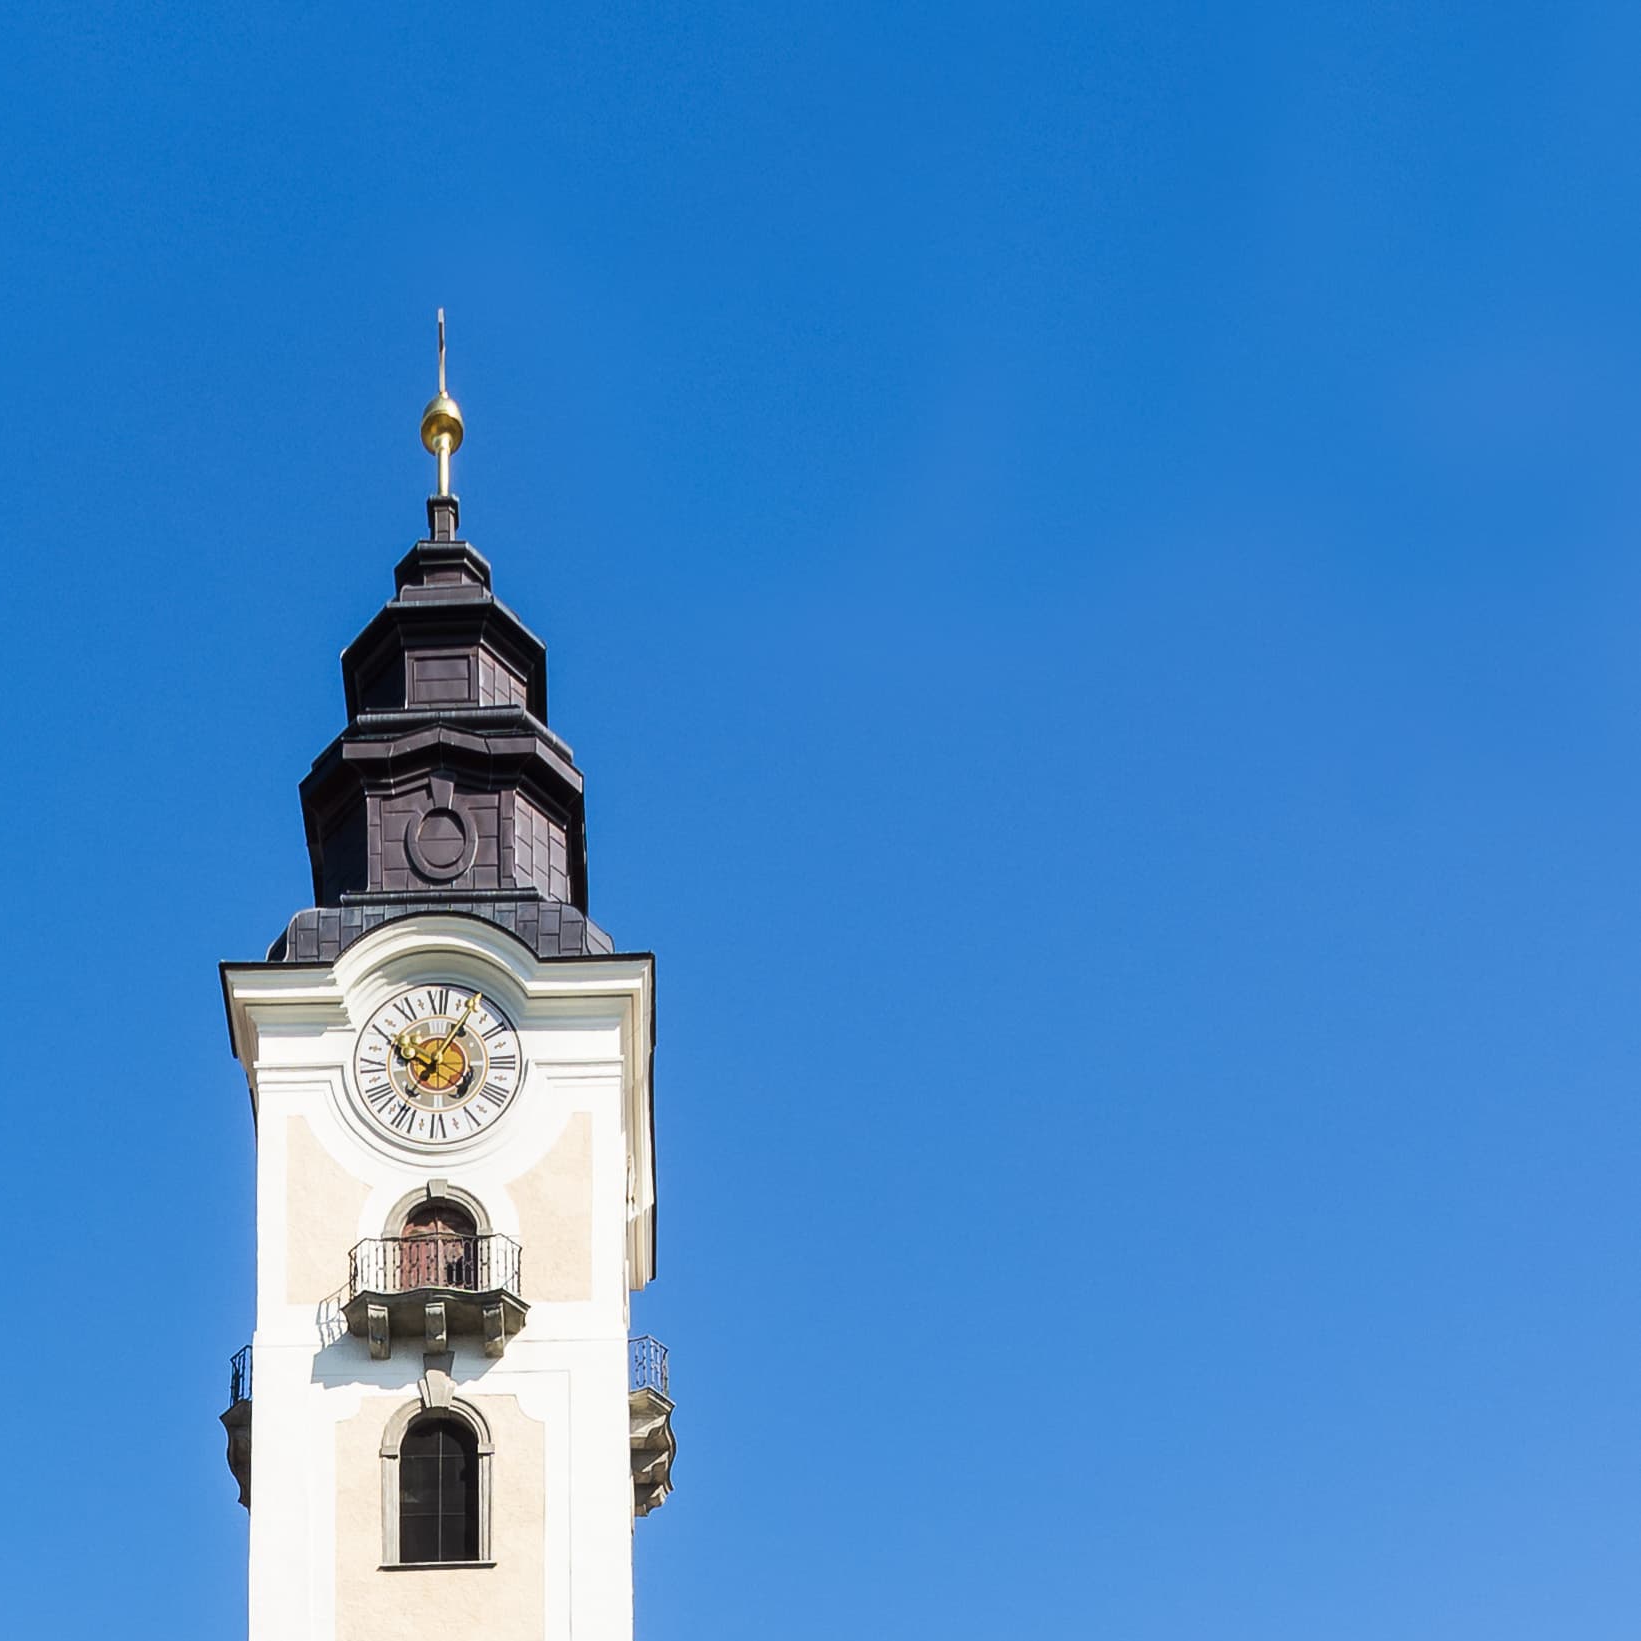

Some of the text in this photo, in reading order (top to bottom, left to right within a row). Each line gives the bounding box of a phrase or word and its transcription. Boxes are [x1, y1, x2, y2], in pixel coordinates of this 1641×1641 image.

[393, 997, 417, 1022] XI
[427, 989, 449, 1015] XII
[360, 1057, 386, 1074] IX
[489, 1055, 516, 1069] III
[365, 1083, 397, 1114] VIII
[479, 1082, 510, 1108] IIII
[429, 1113, 447, 1139] VI
[463, 1106, 481, 1131] V
